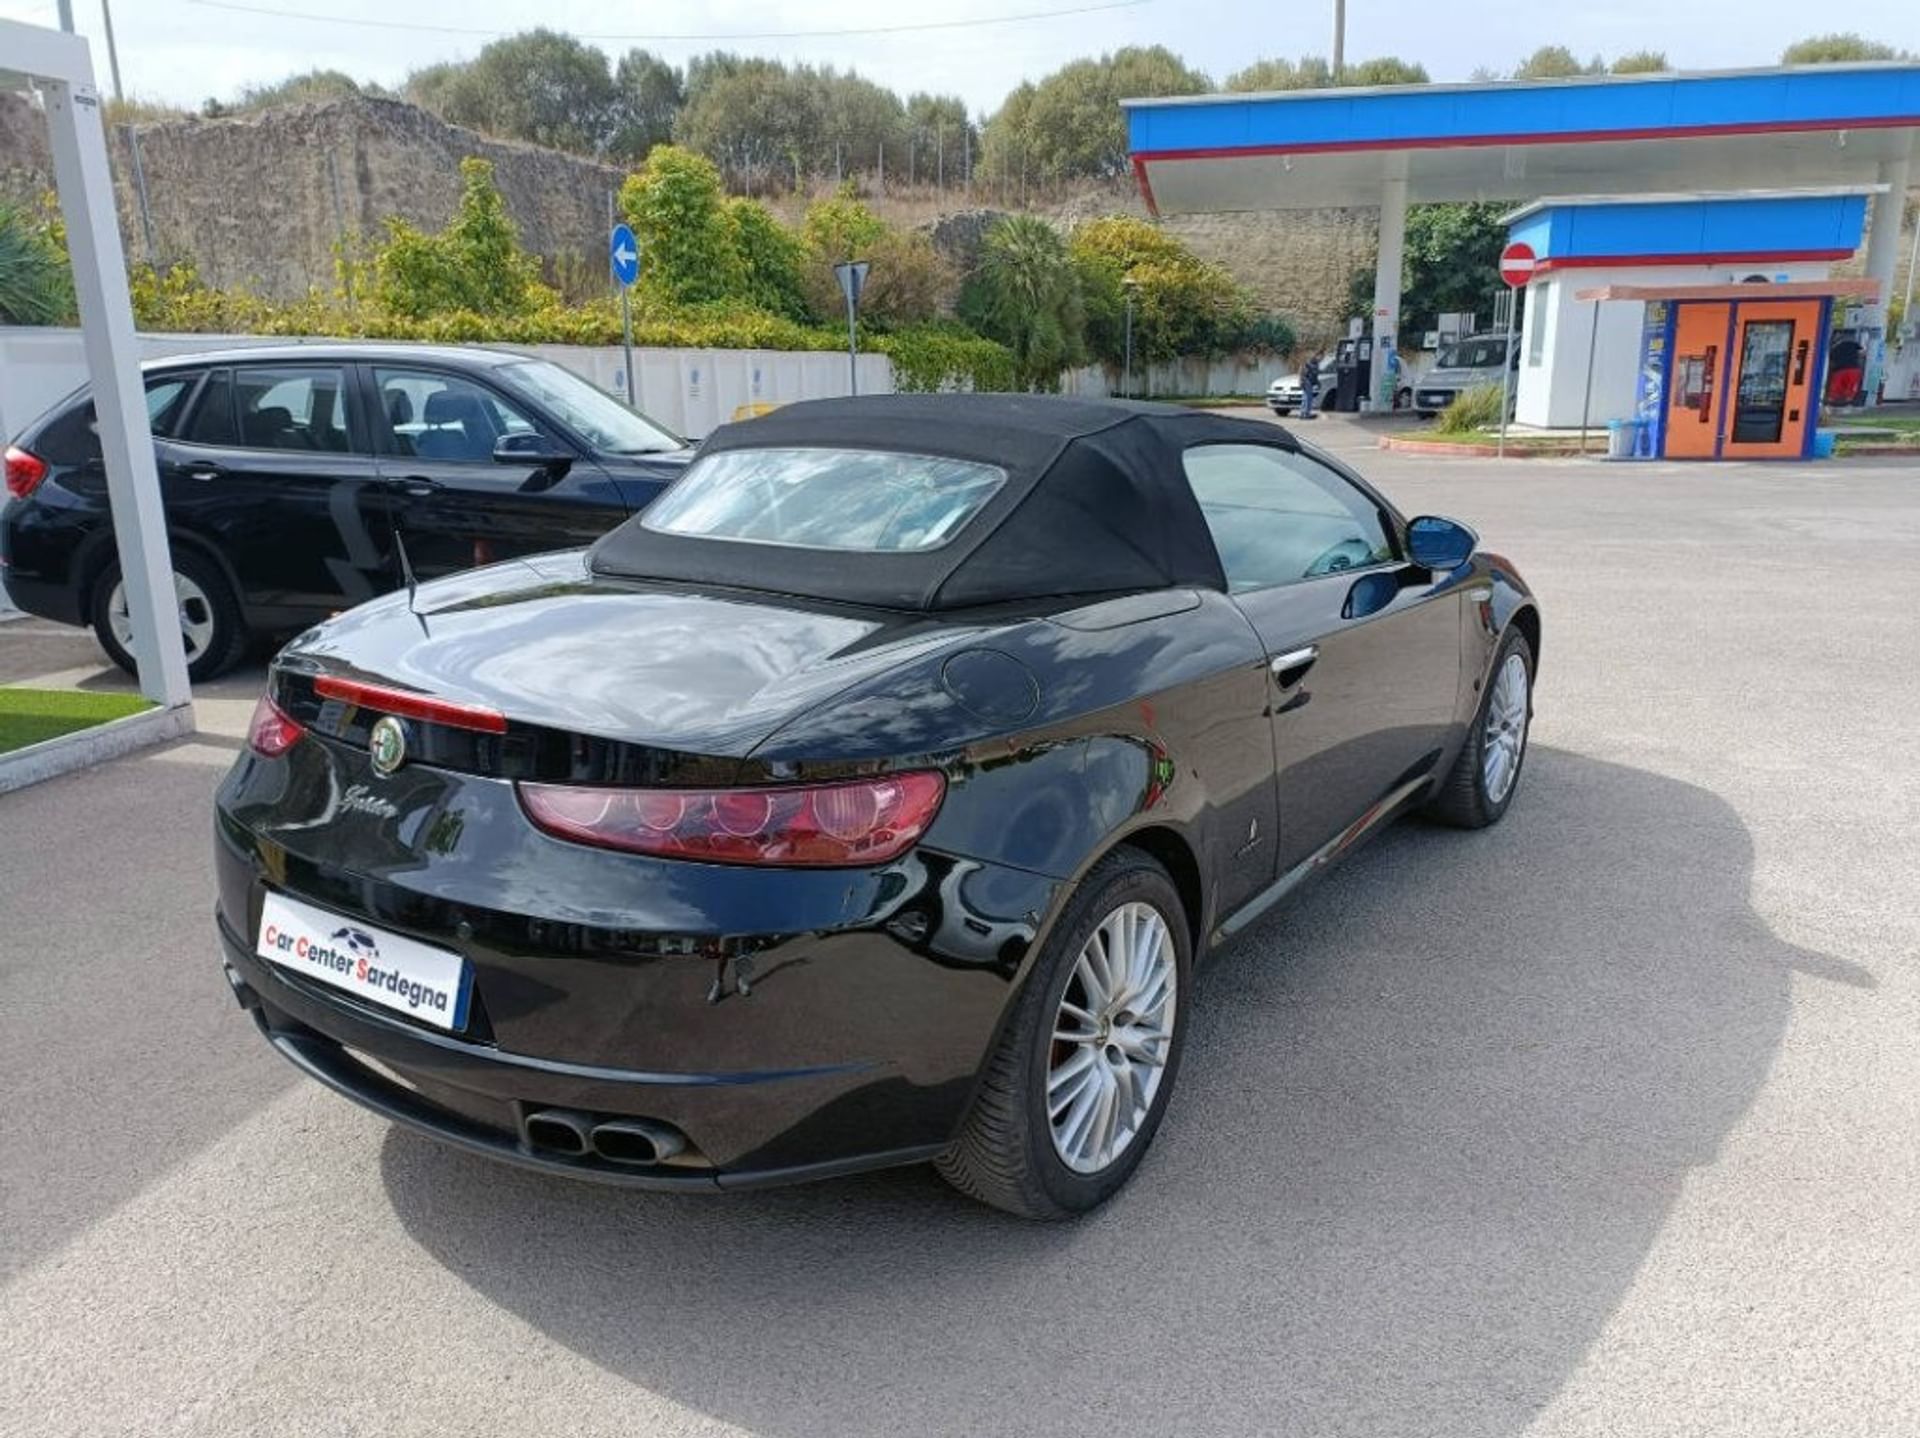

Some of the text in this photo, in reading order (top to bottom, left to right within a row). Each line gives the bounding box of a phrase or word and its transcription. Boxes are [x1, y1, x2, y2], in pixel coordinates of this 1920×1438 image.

[266, 925, 448, 1012] Car Center Sardegna
